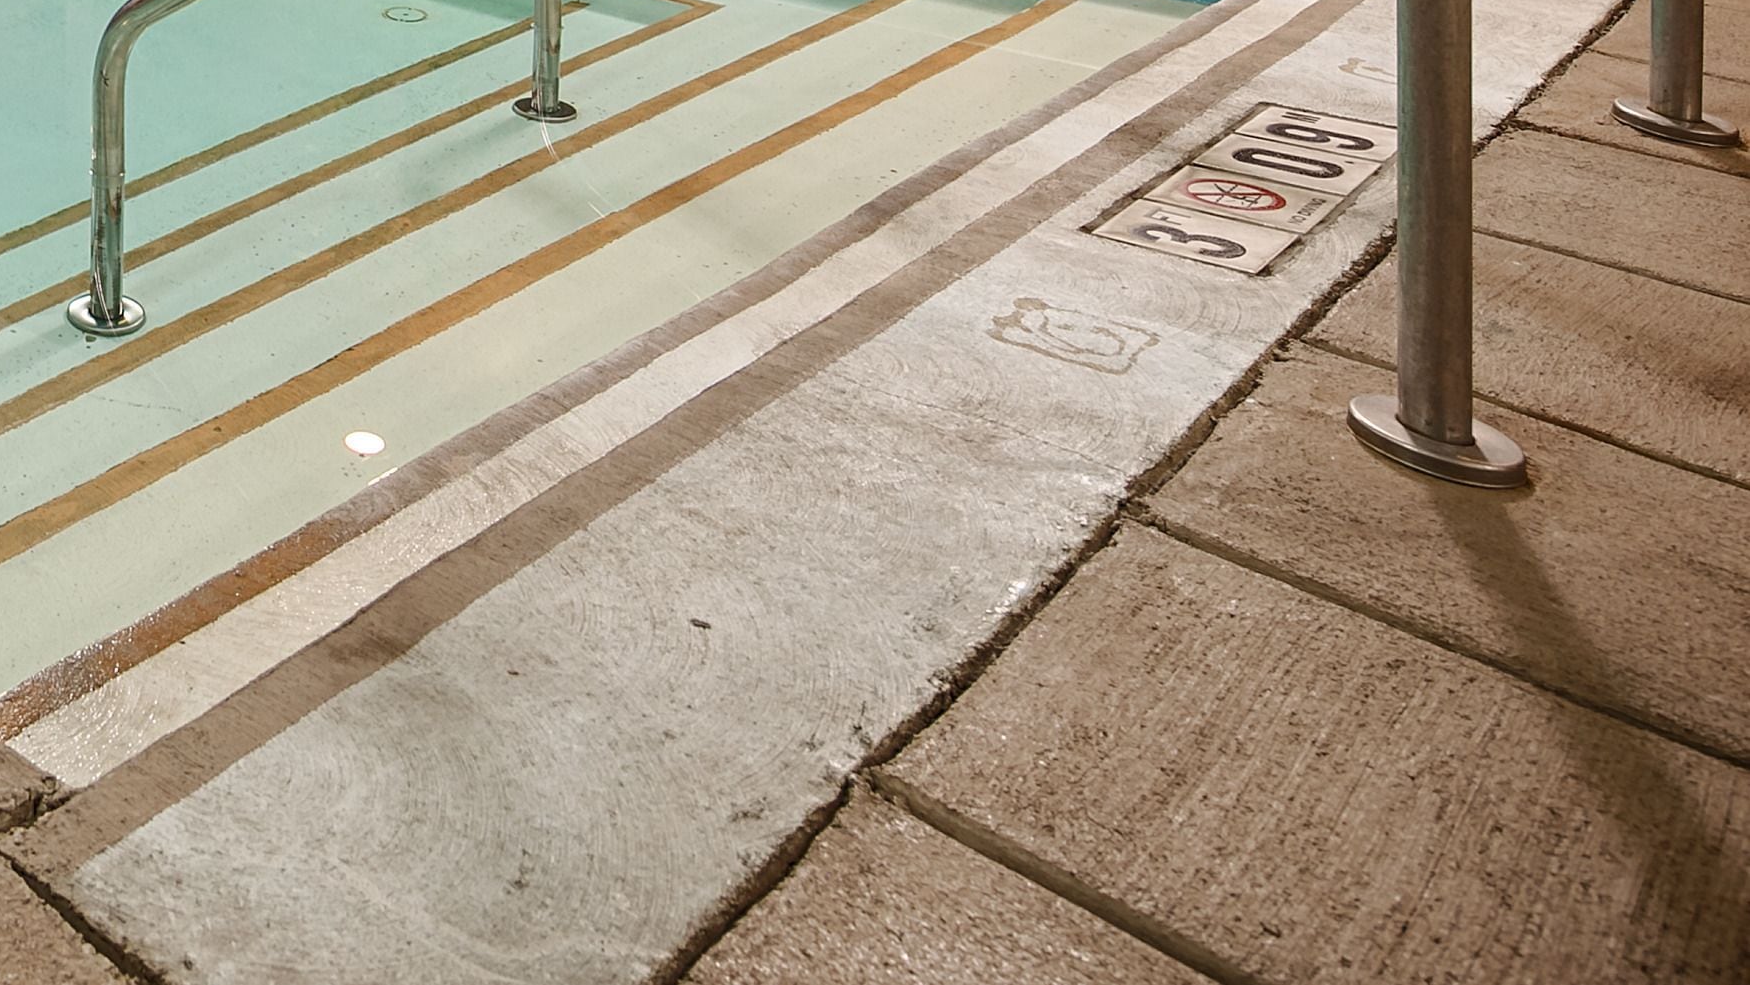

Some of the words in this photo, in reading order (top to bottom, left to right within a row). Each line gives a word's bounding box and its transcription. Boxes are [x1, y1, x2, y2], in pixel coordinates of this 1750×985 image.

[1143, 207, 1192, 225] FT
[1297, 198, 1328, 216] DIVING
[1134, 224, 1247, 259] 3
